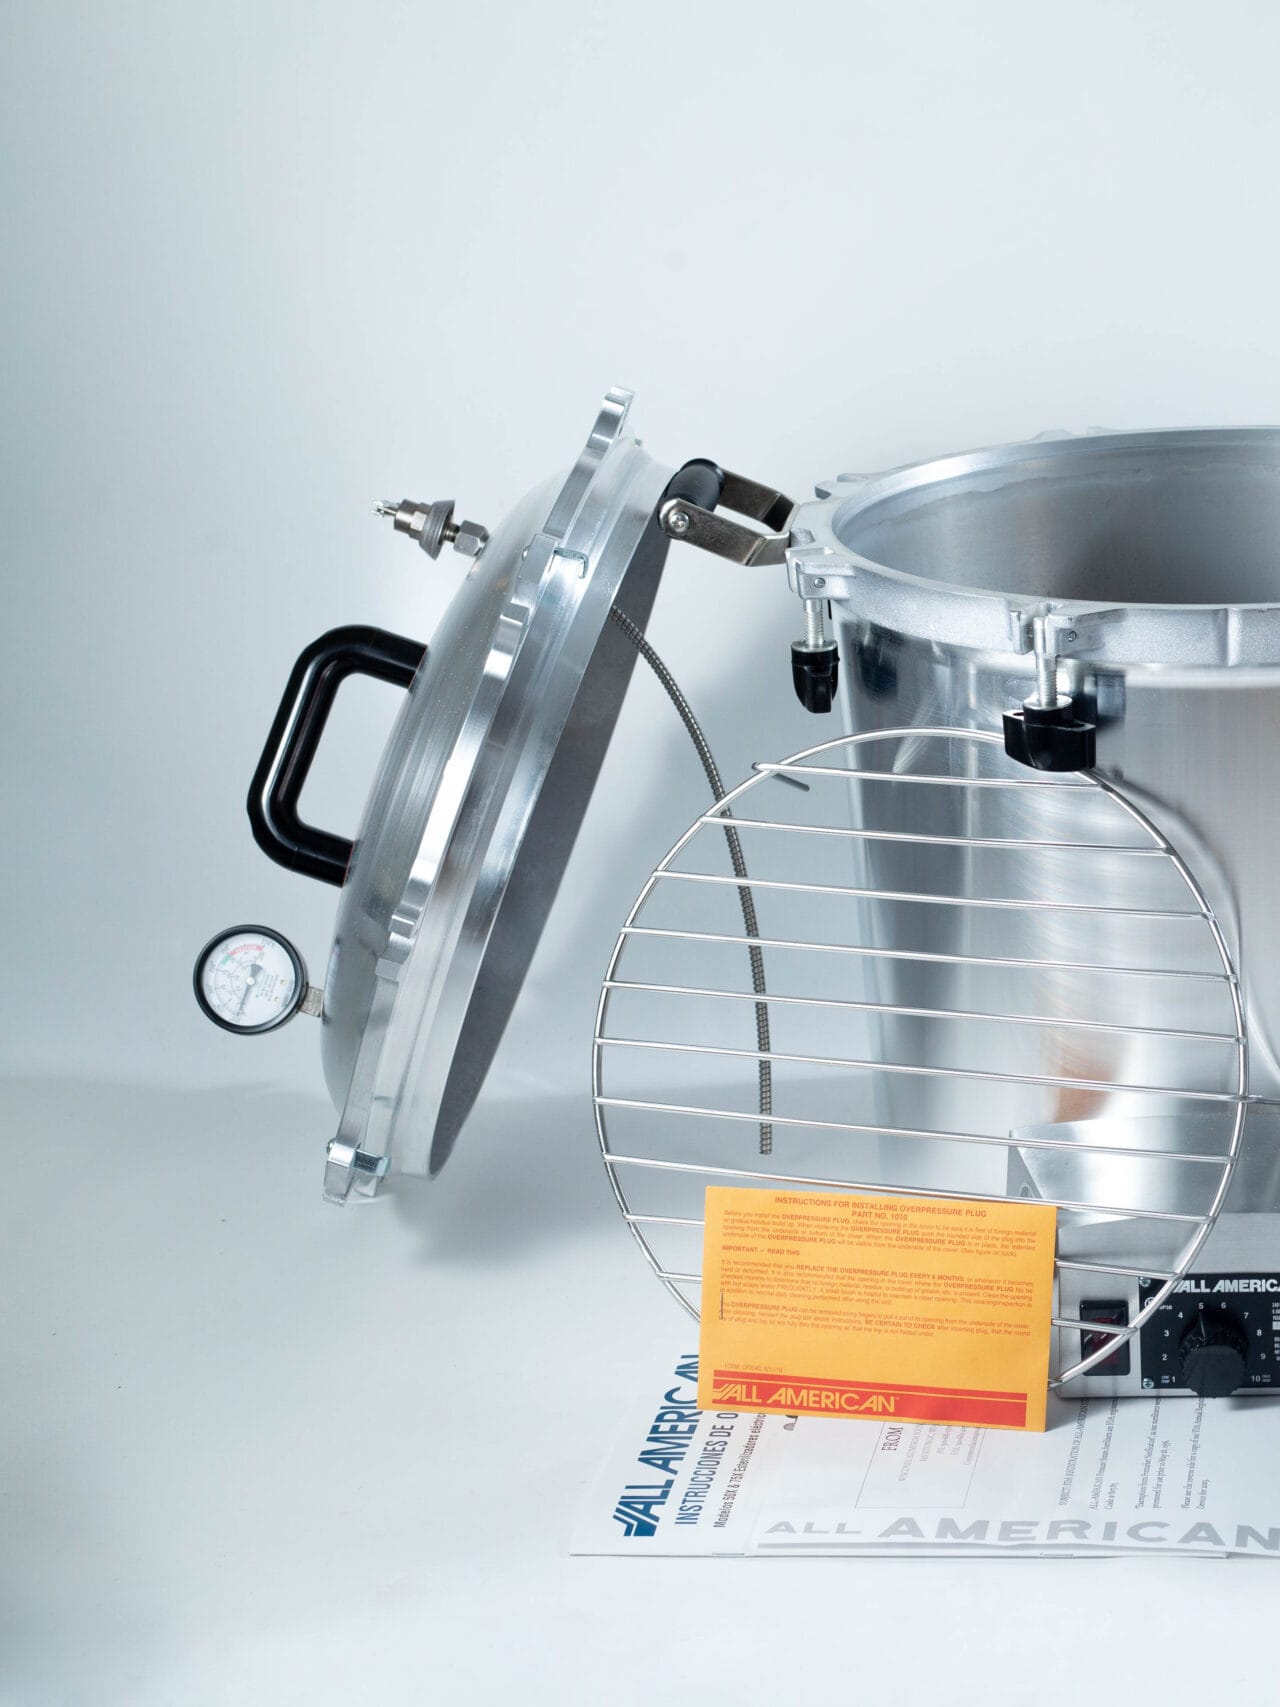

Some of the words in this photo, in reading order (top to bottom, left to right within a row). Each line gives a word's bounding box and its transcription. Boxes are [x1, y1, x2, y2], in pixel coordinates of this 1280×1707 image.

[775, 1196, 831, 1207] INSTRUCTIONS
[833, 1200, 849, 1208] FOR
[851, 1201, 897, 1211] INSTALLING
[899, 1205, 962, 1216] OVERPRESSURE
[965, 1209, 986, 1217] PLUG
[781, 1214, 831, 1222] OVERPRESSURE
[851, 1210, 872, 1218] PART
[851, 1226, 901, 1235] OVERPRESSURE
[768, 1234, 817, 1242] OVERPRESSURE
[895, 1236, 945, 1245] OVERPRESSURE
[722, 1245, 757, 1253] IMPORTANT
[840, 1267, 889, 1276] OVERPRESSURE
[943, 1282, 994, 1291] OVERPRESSURE
[1175, 1279, 1211, 1293] ALL
[731, 1302, 780, 1311] OVERPRESSURE
[722, 1384, 762, 1403] ALL
[766, 1388, 895, 1413] AMERICAN
[882, 1427, 904, 1451] FROM
[674, 1440, 728, 1525] INSTRUCCIONES
[709, 1425, 734, 1437] DE
[713, 1502, 731, 1528] Modelos
[734, 1434, 757, 1472] Esterilizadores
[618, 1479, 675, 1522] ALL
[764, 1520, 862, 1536] ALL
